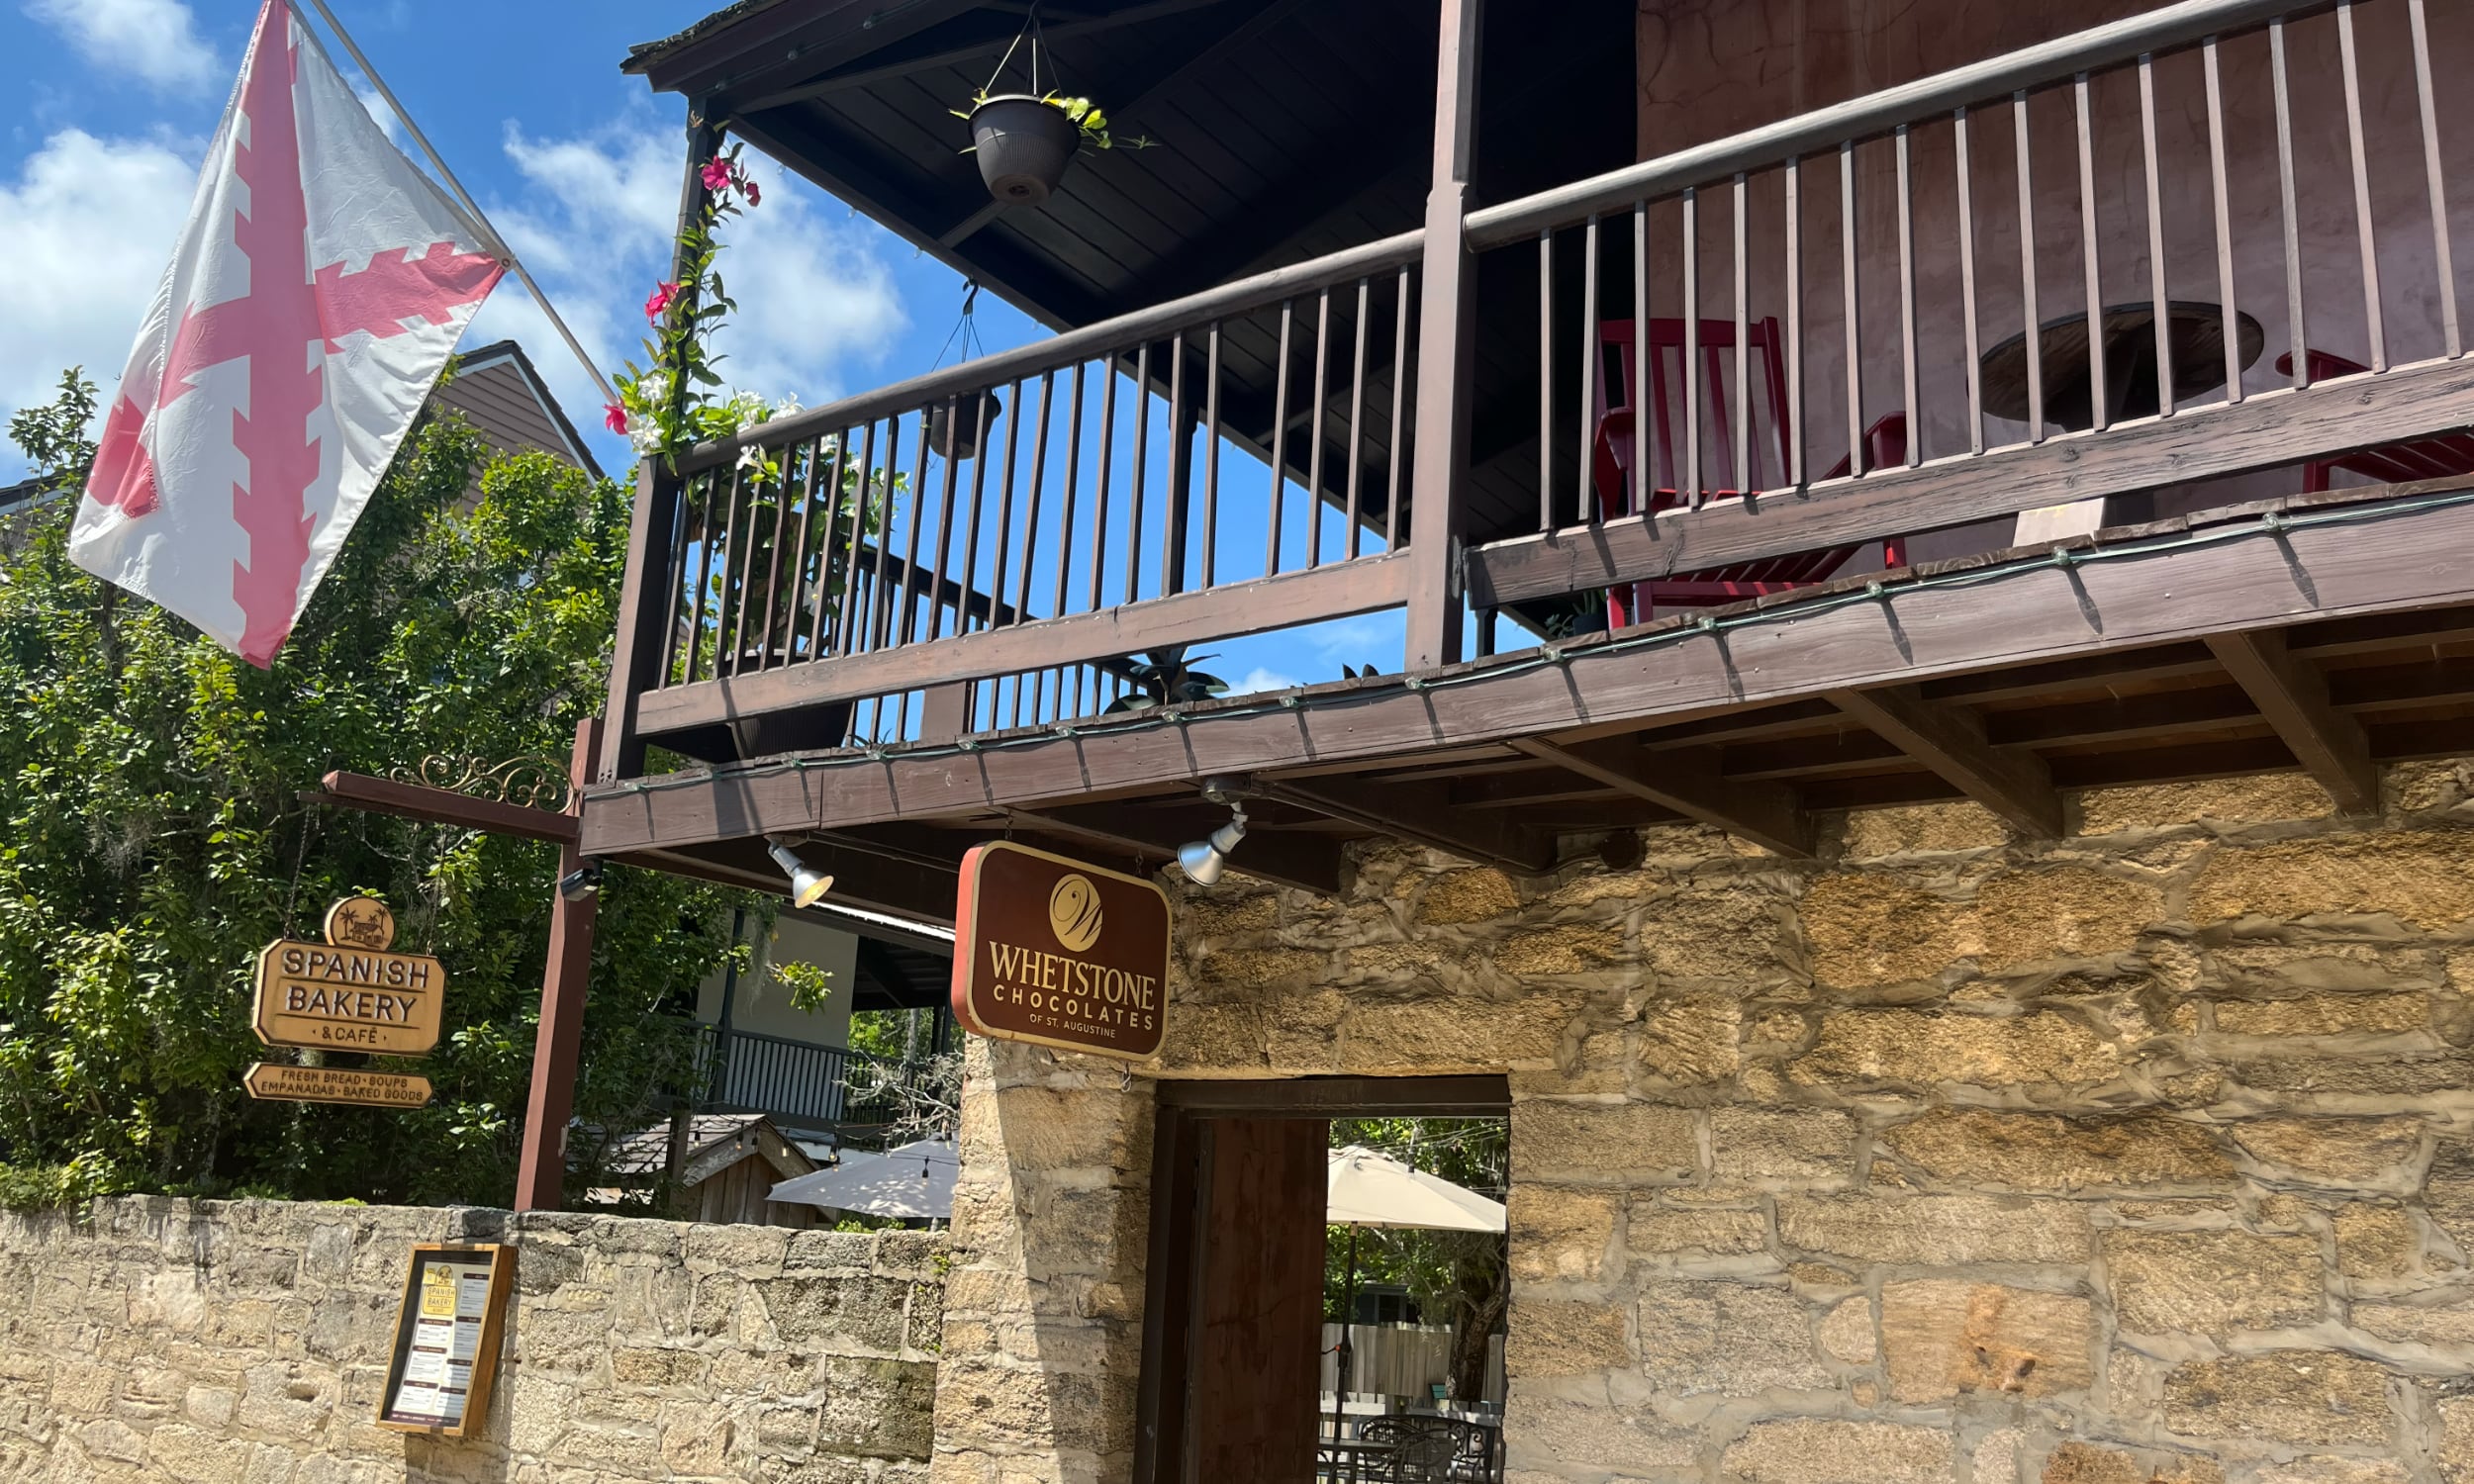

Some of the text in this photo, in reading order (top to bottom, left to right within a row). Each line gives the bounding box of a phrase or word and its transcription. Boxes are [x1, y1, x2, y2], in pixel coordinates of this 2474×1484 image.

[283, 949, 428, 988] SPANISH
[990, 940, 1156, 1011] WHETSTONE
[285, 985, 417, 1023] BAKERY
[994, 984, 1153, 1031] CHOCOLATES
[322, 1026, 332, 1040] &
[1029, 1013, 1116, 1039] OF ST. AUGUSTINE
[281, 1069, 408, 1088] FRESH BREAD SOUPS
[261, 1081, 424, 1101] EMPANADAS BAKED GOODS
[428, 1287, 455, 1296] SPANISH
[428, 1297, 451, 1307] BAKERY
